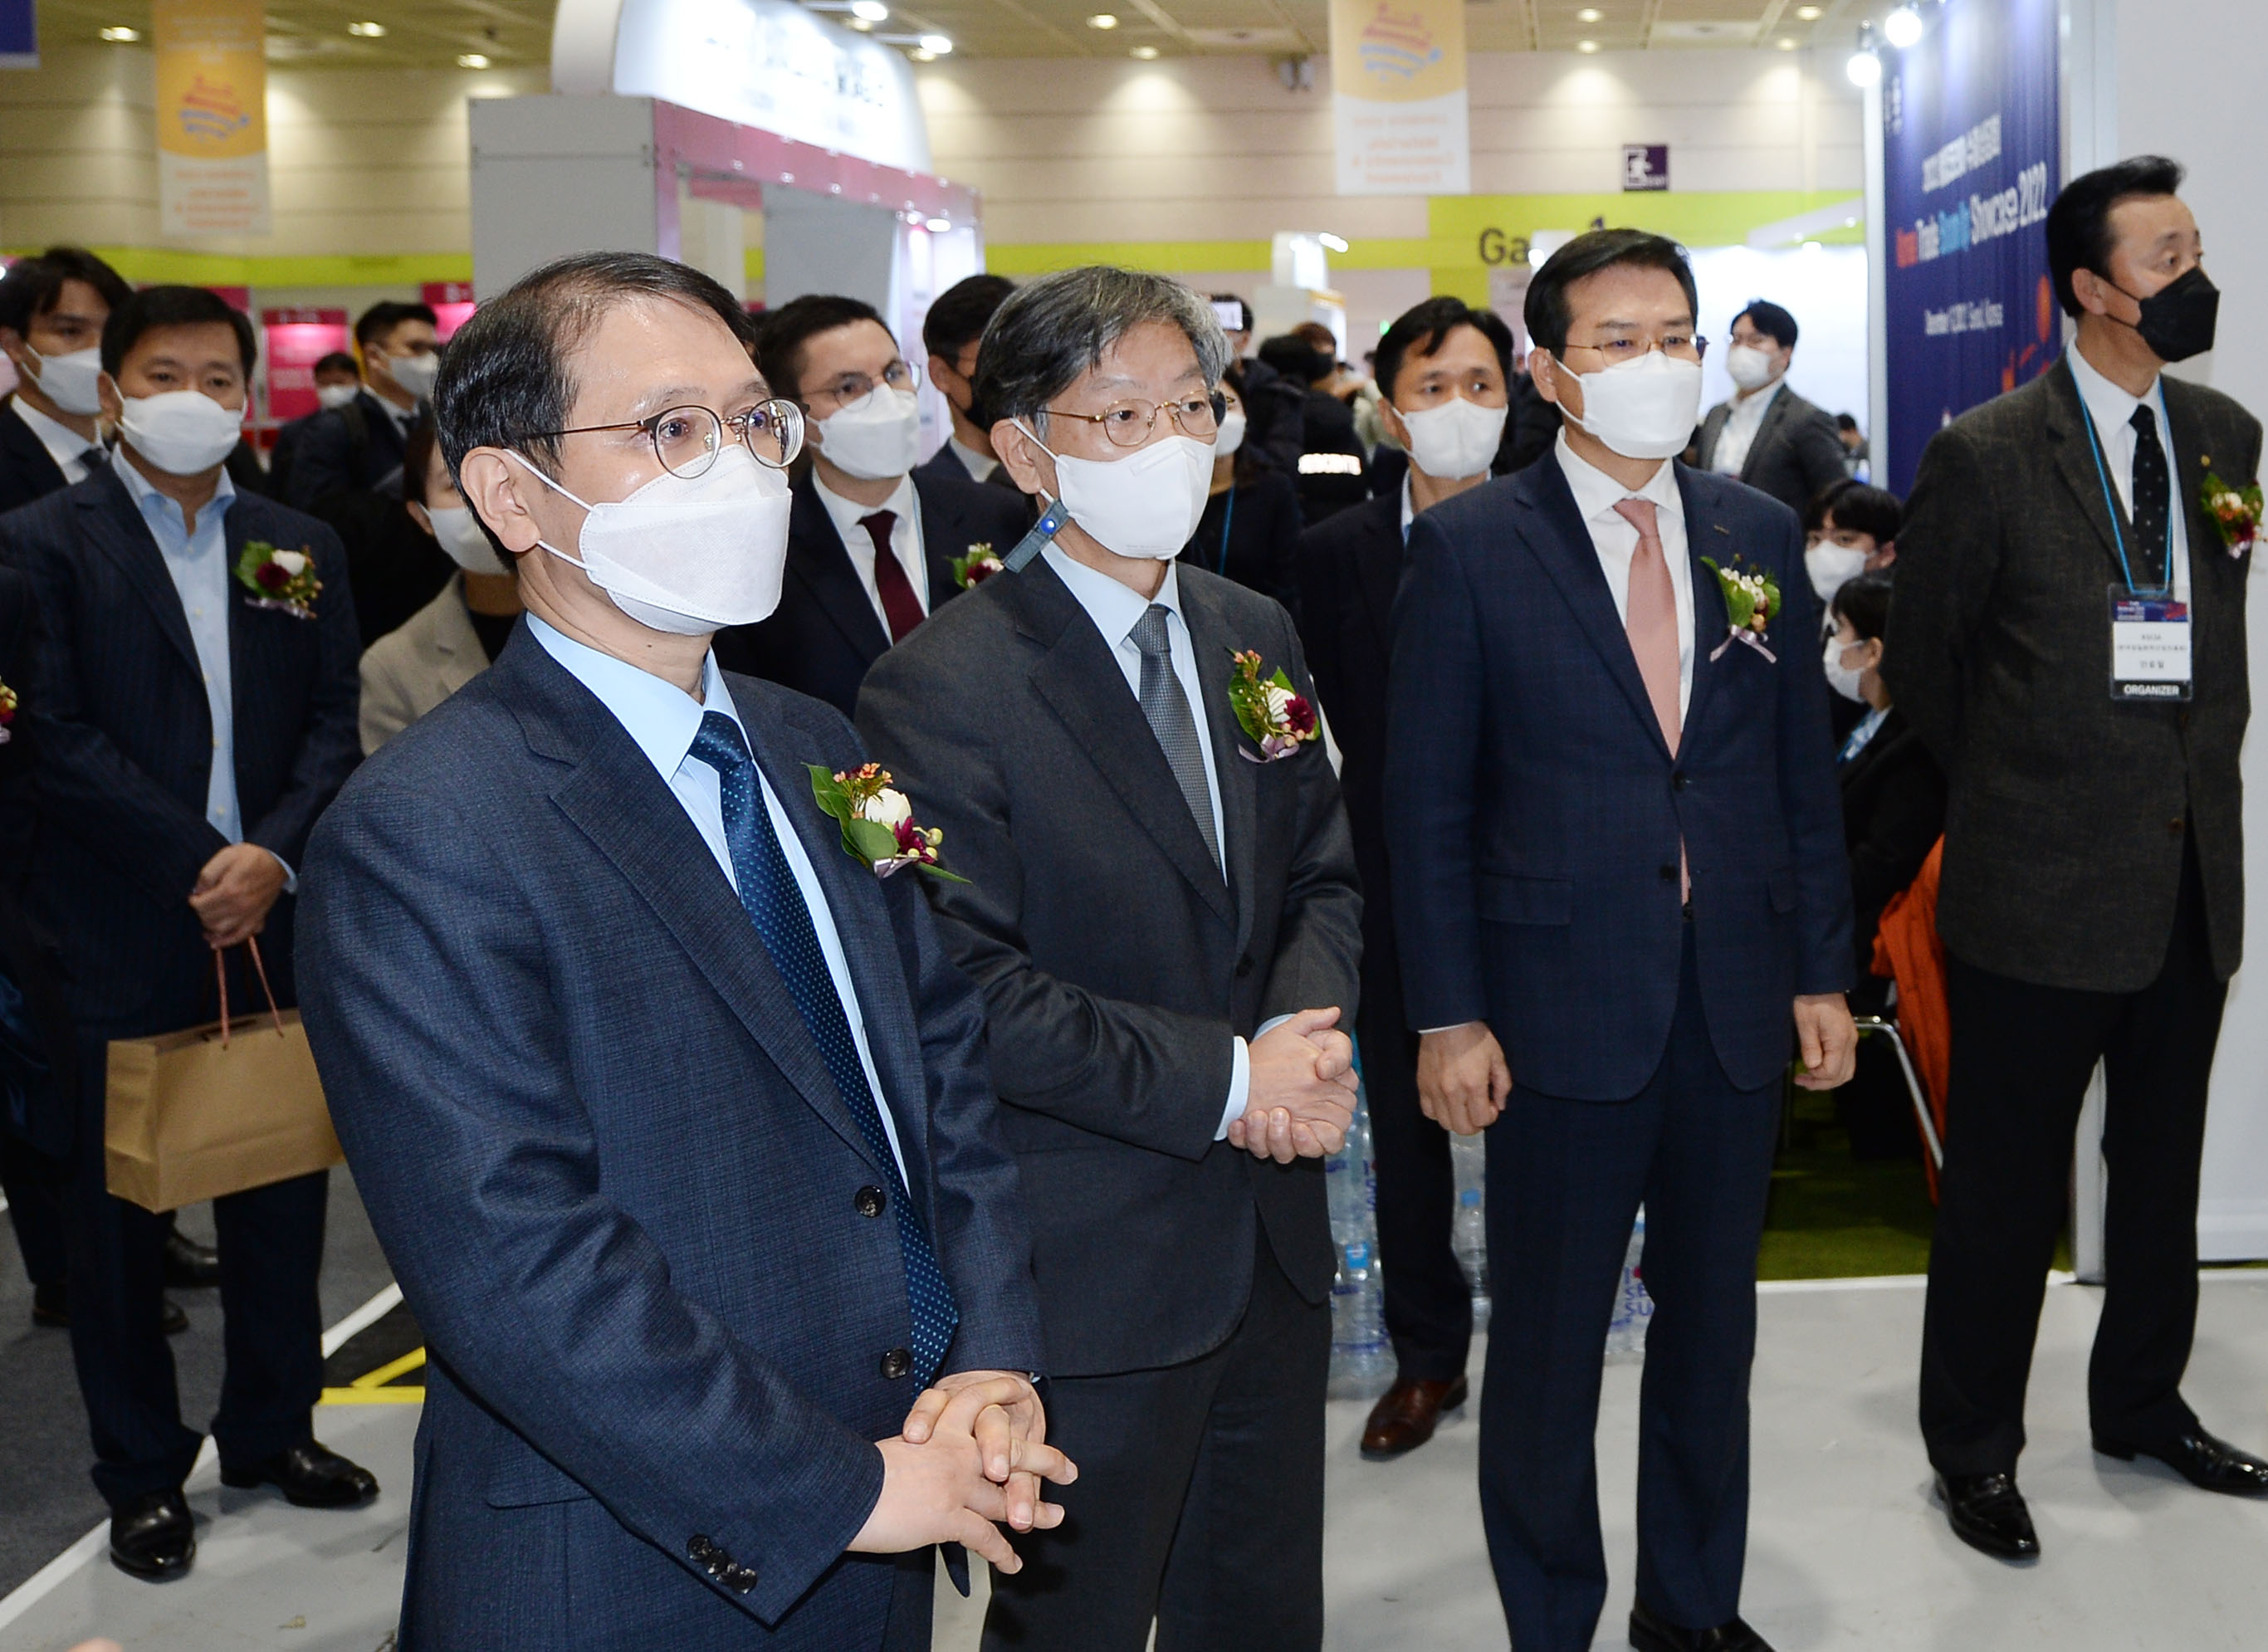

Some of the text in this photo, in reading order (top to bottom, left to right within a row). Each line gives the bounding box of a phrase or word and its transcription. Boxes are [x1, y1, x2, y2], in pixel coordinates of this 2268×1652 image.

[2018, 159, 2047, 227] 2022
[1479, 227, 1531, 265] Ga
[2124, 684, 2179, 696] ORGANIZER
